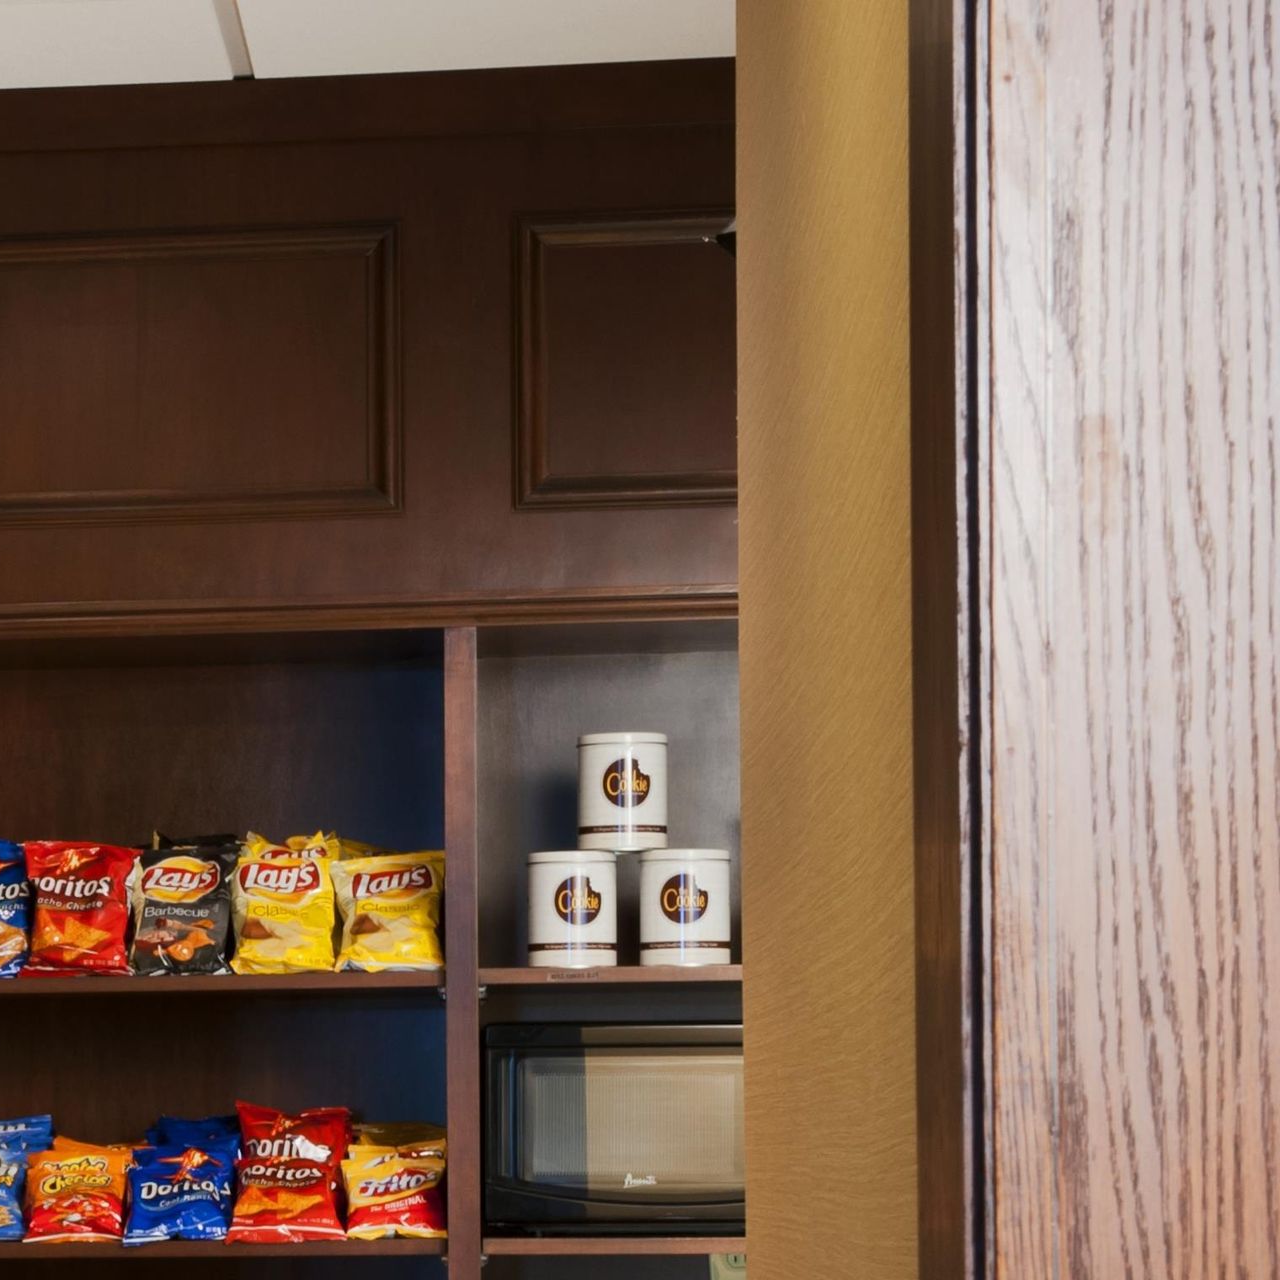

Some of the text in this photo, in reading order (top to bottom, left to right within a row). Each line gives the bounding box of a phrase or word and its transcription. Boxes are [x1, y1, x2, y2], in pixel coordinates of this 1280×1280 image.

[606, 768, 649, 796] Cookie
[144, 905, 209, 918] Barbecue
[663, 886, 706, 912] Cookie
